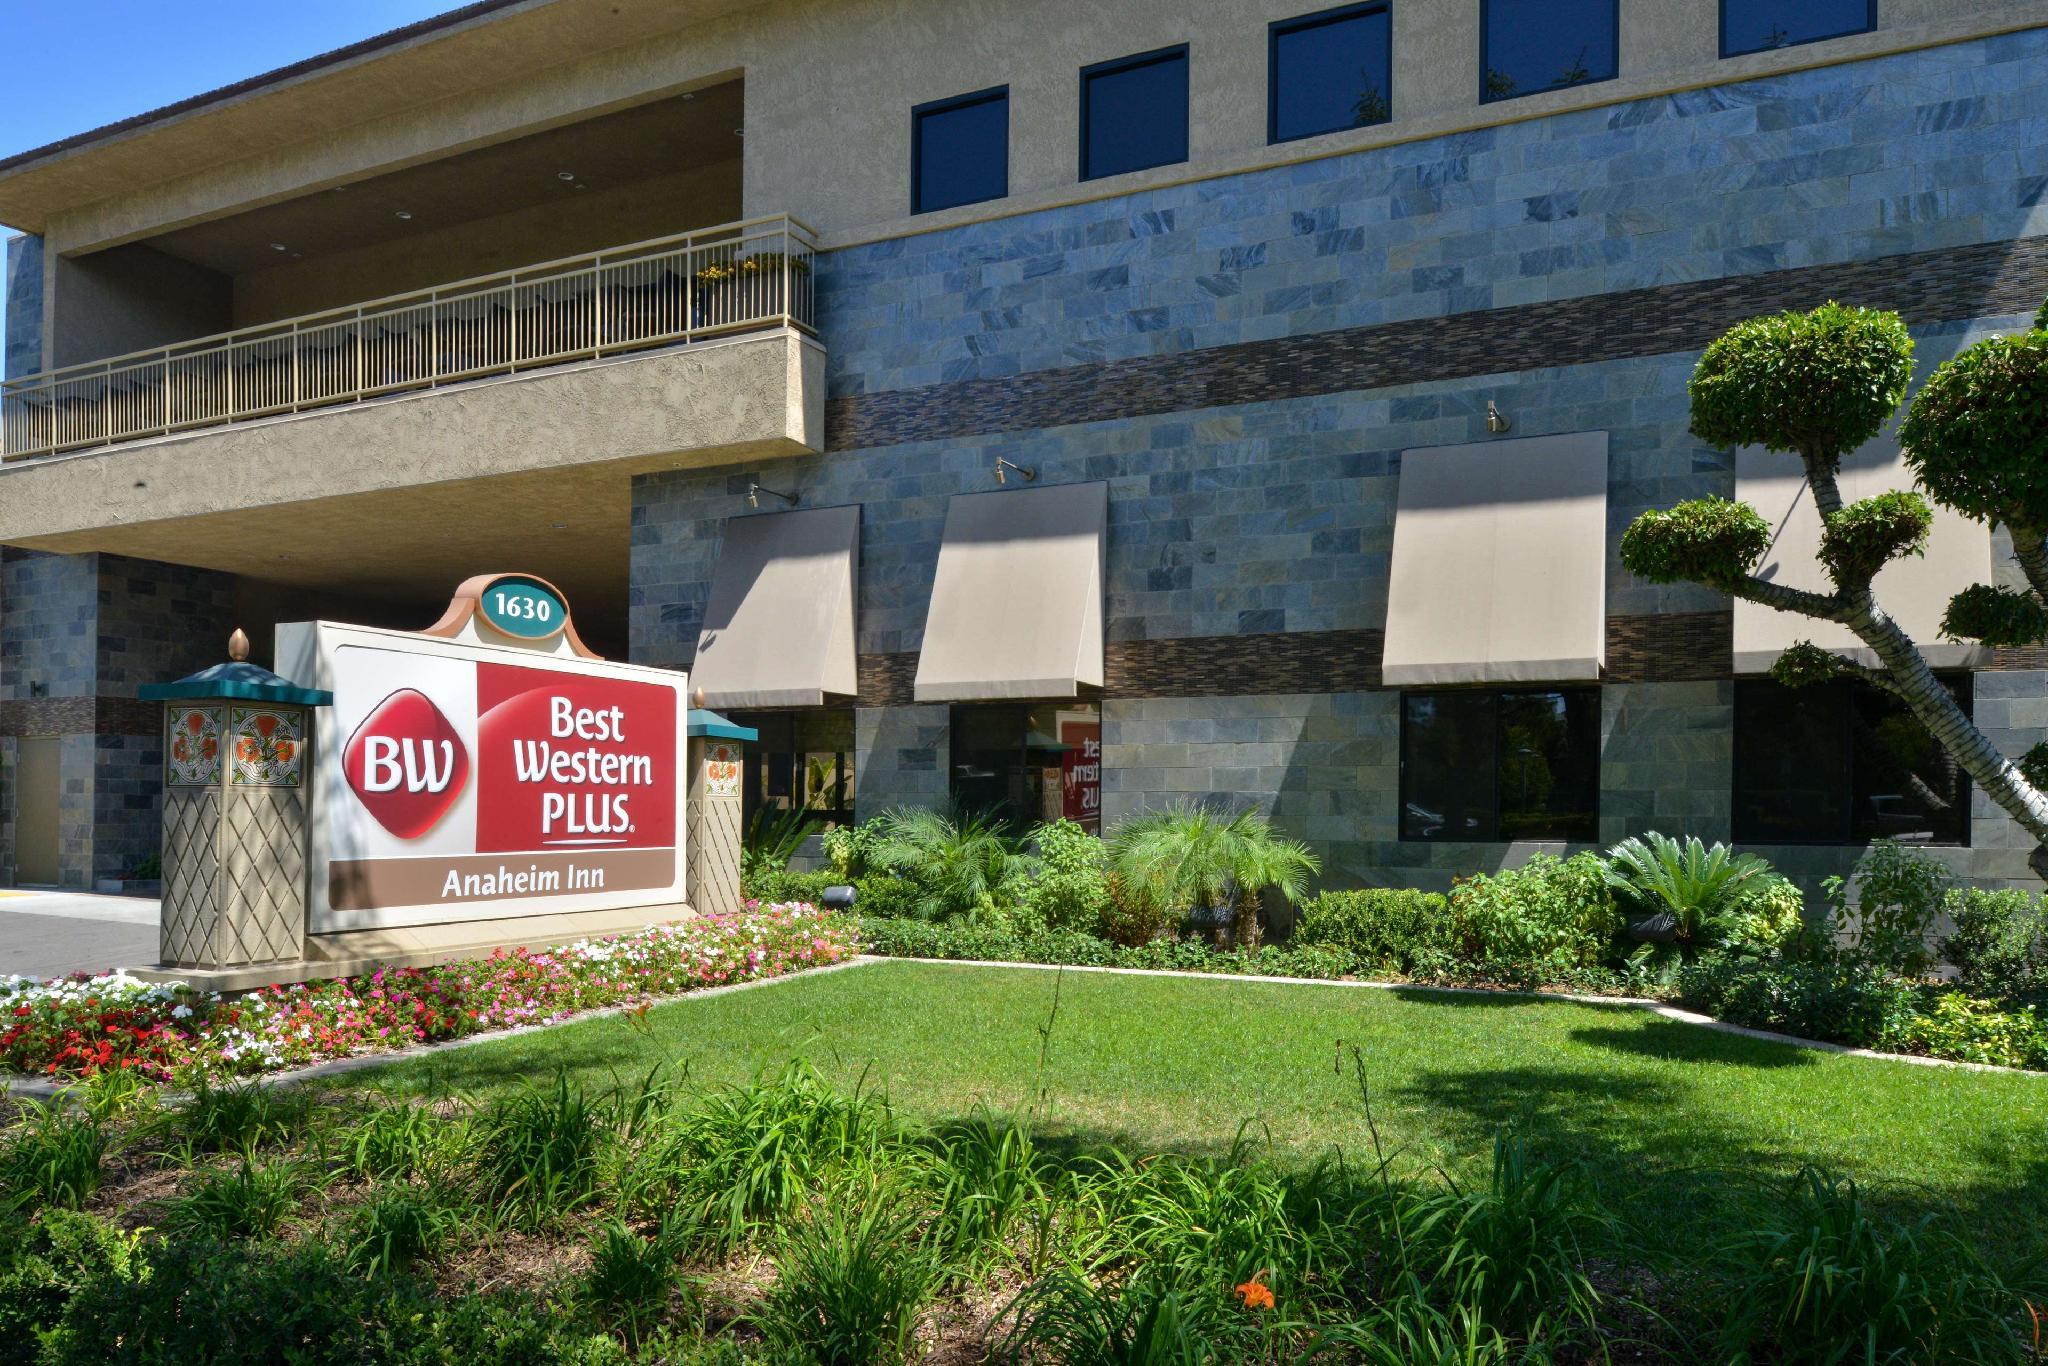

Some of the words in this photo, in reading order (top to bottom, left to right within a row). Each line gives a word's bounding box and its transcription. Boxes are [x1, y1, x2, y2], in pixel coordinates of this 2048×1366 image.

[495, 592, 551, 622] 1630
[550, 696, 626, 742] Best
[363, 735, 454, 794] BW
[513, 738, 653, 786] Western
[441, 864, 561, 898] Anaheim
[567, 864, 605, 889] Inn
